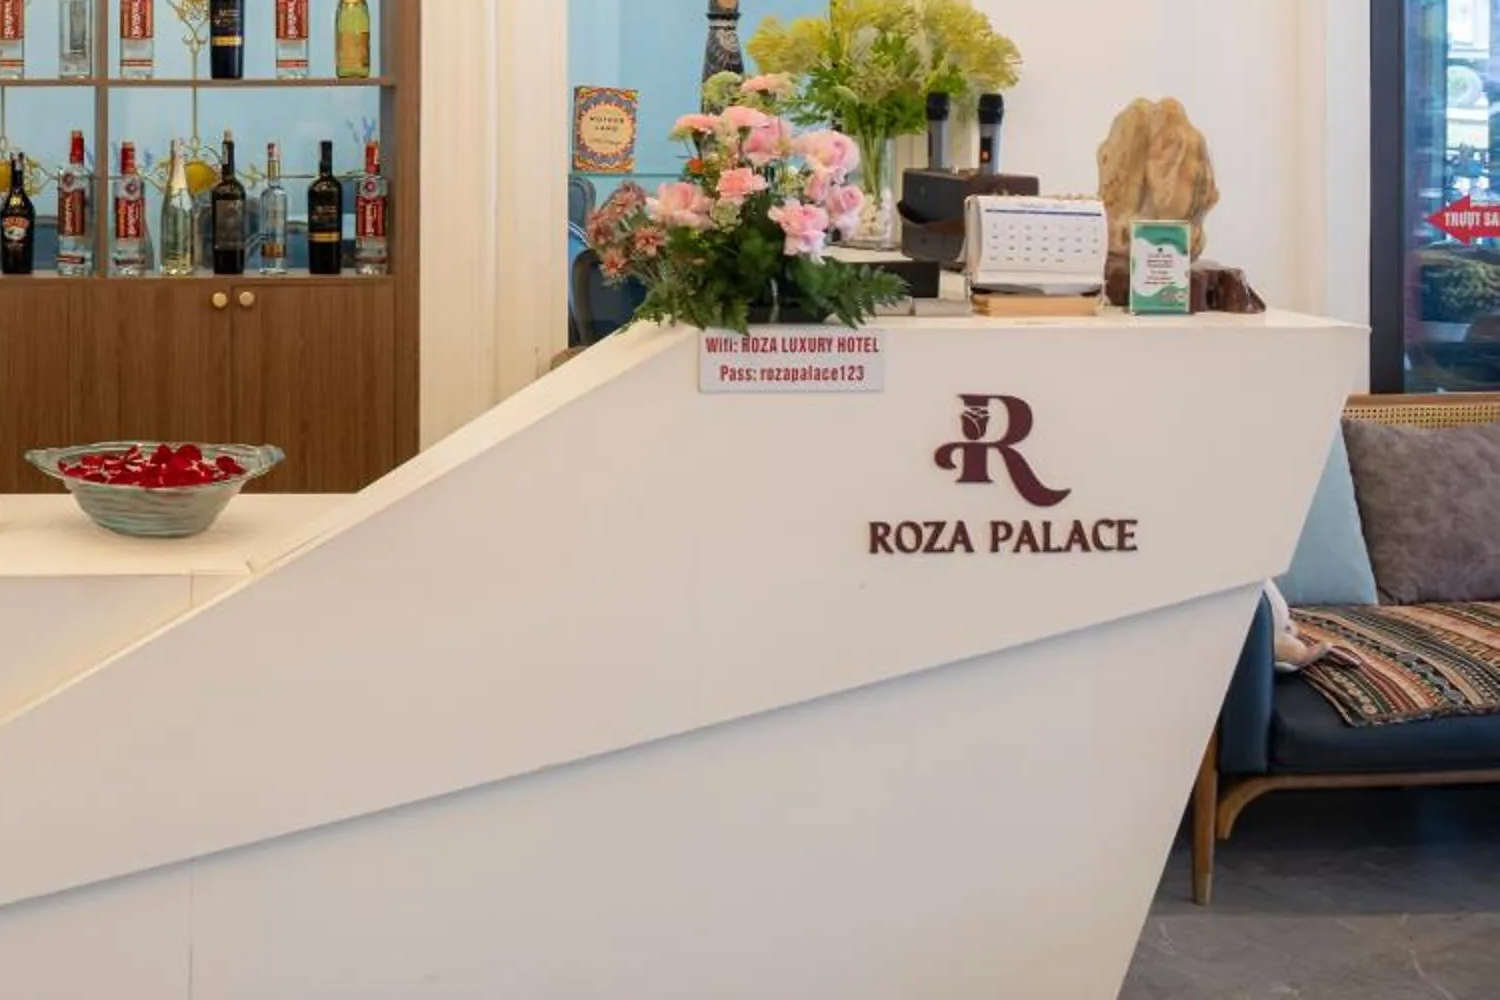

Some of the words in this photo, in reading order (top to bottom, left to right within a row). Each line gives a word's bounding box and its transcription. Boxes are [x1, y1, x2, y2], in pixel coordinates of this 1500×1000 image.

[741, 335, 777, 353] ROZA
[781, 336, 833, 353] LUXURY
[837, 336, 880, 353] HOTEL
[720, 364, 757, 382] Pass:
[760, 364, 865, 383] rozapalace123
[868, 519, 975, 554] ROZA
[989, 518, 1139, 553] PALACE
